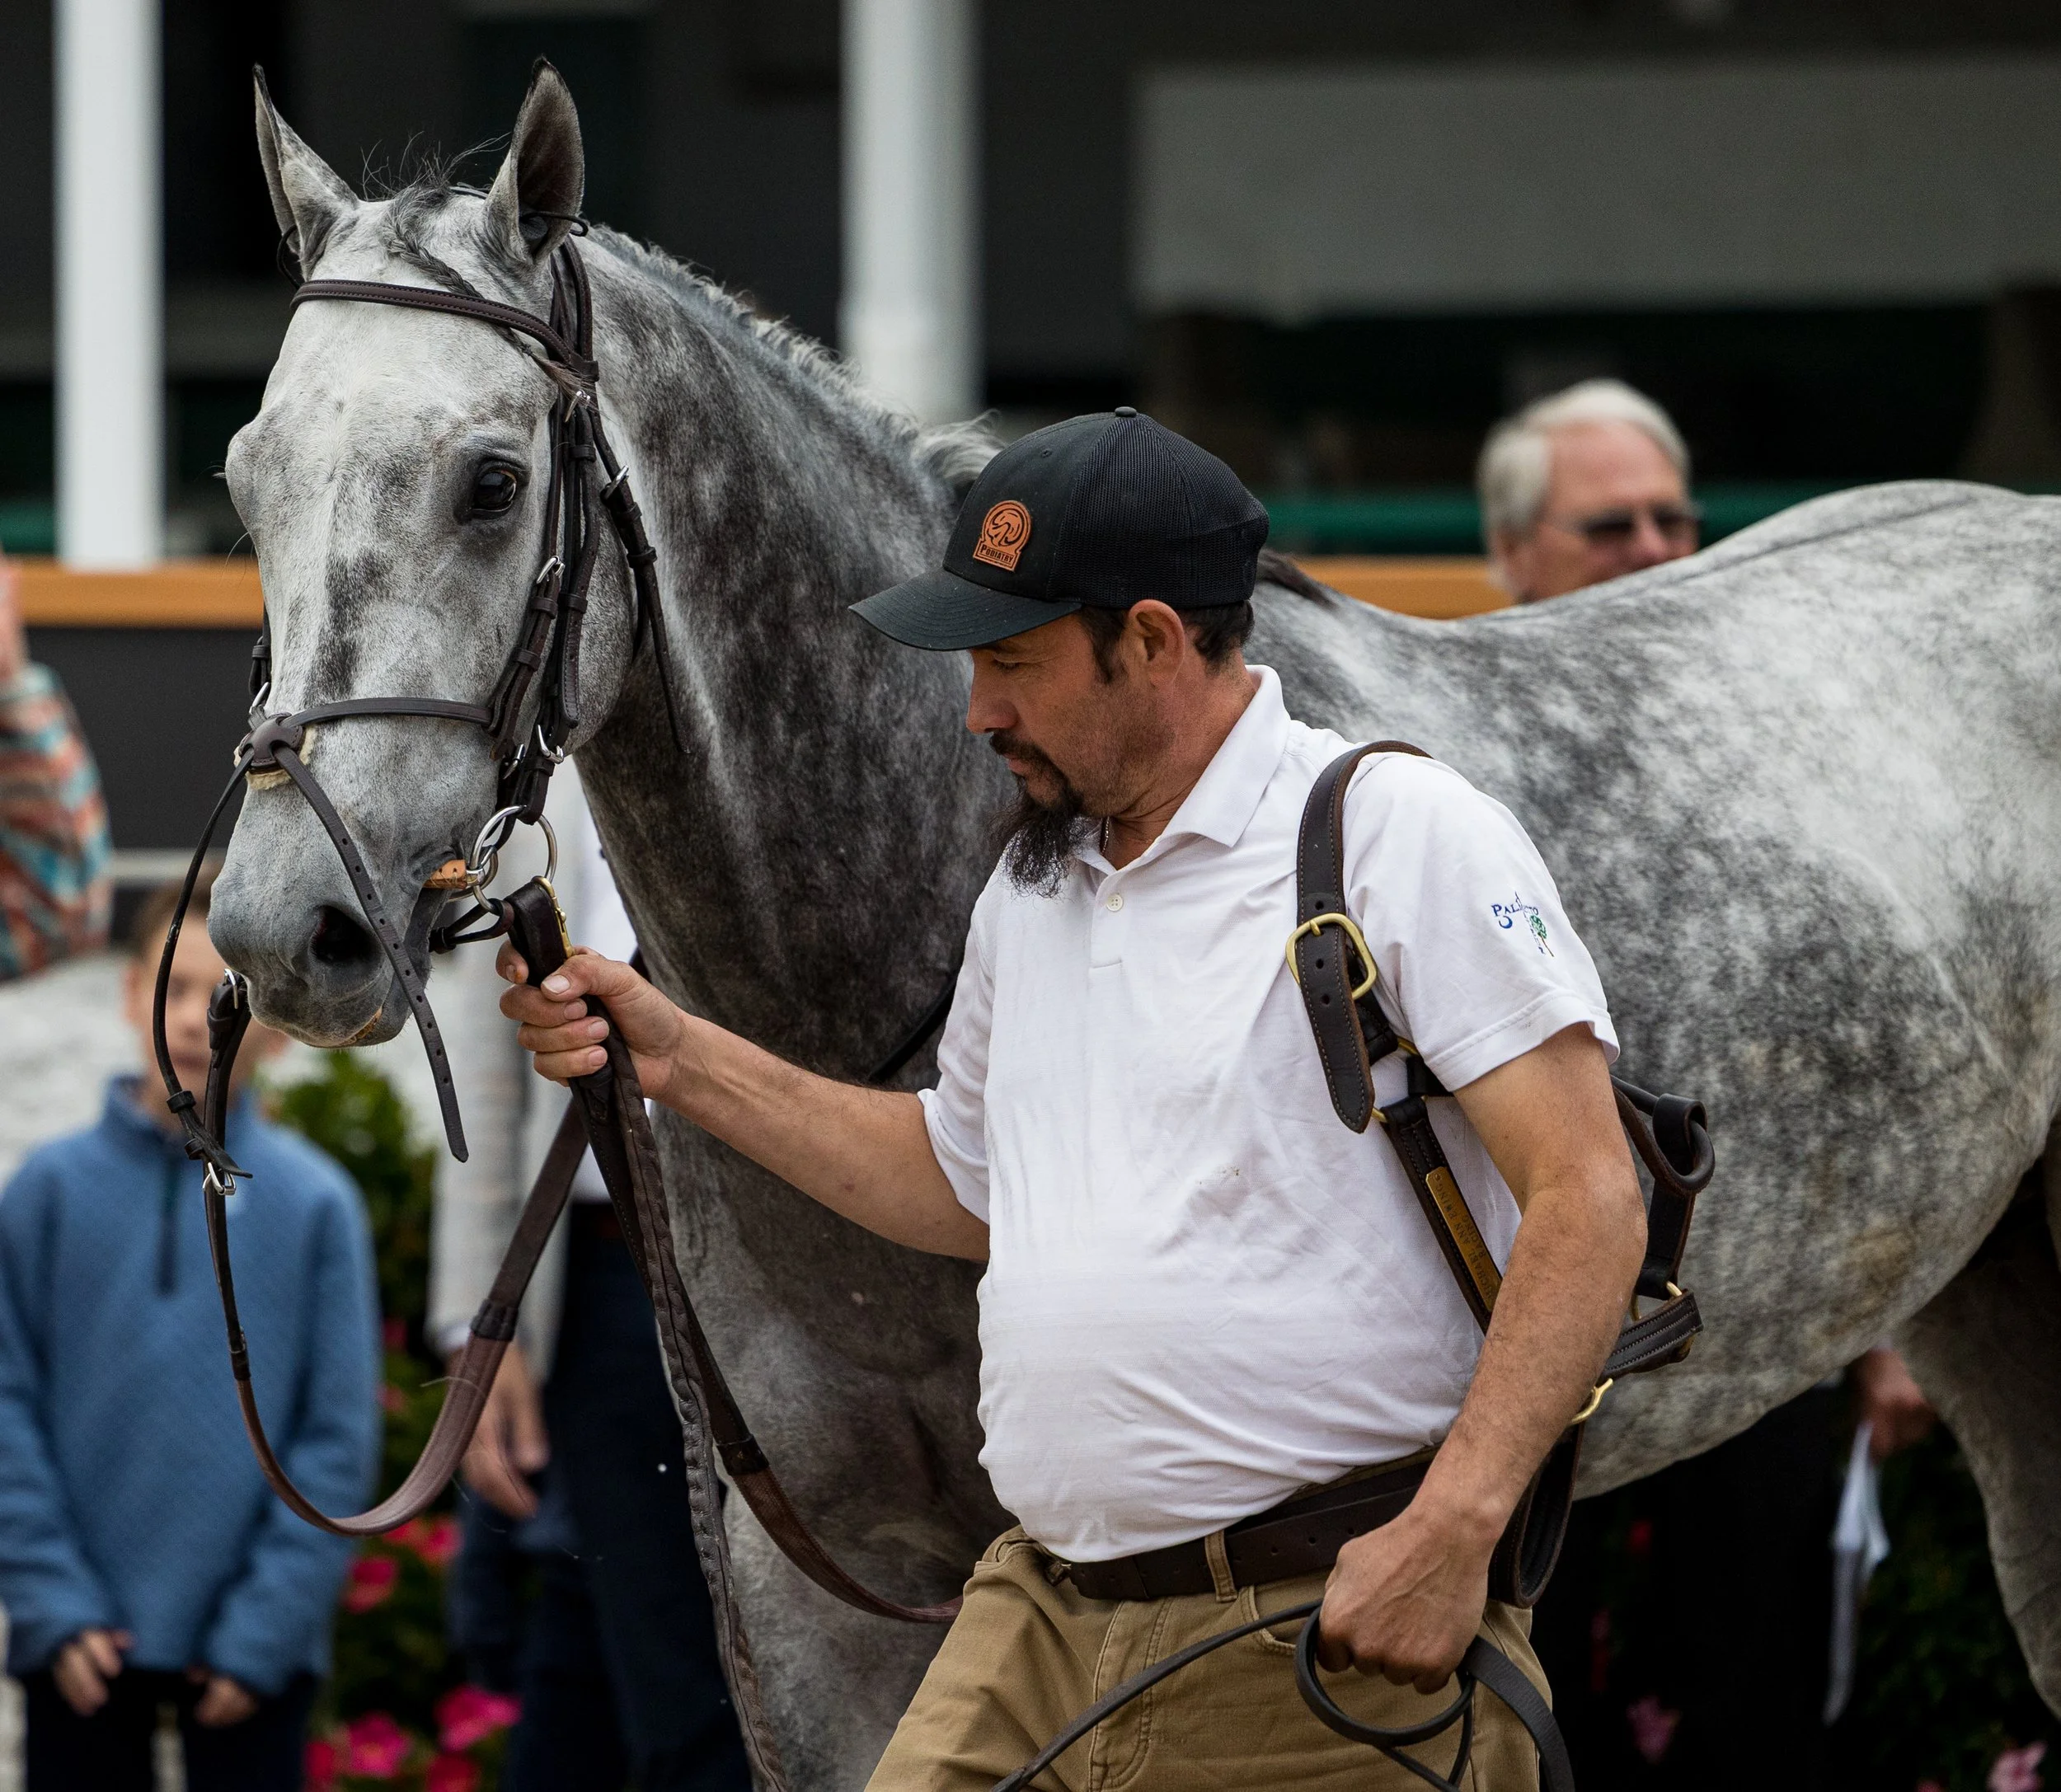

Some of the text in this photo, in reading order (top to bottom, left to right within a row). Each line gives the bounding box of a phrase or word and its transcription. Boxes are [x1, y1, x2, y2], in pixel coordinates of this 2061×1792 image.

[980, 544, 1014, 562] PODIATRY
[1435, 1183, 1458, 1220] EWING
[1453, 1222, 1471, 1245] ANN
[1462, 1214, 1486, 1258] RACING
